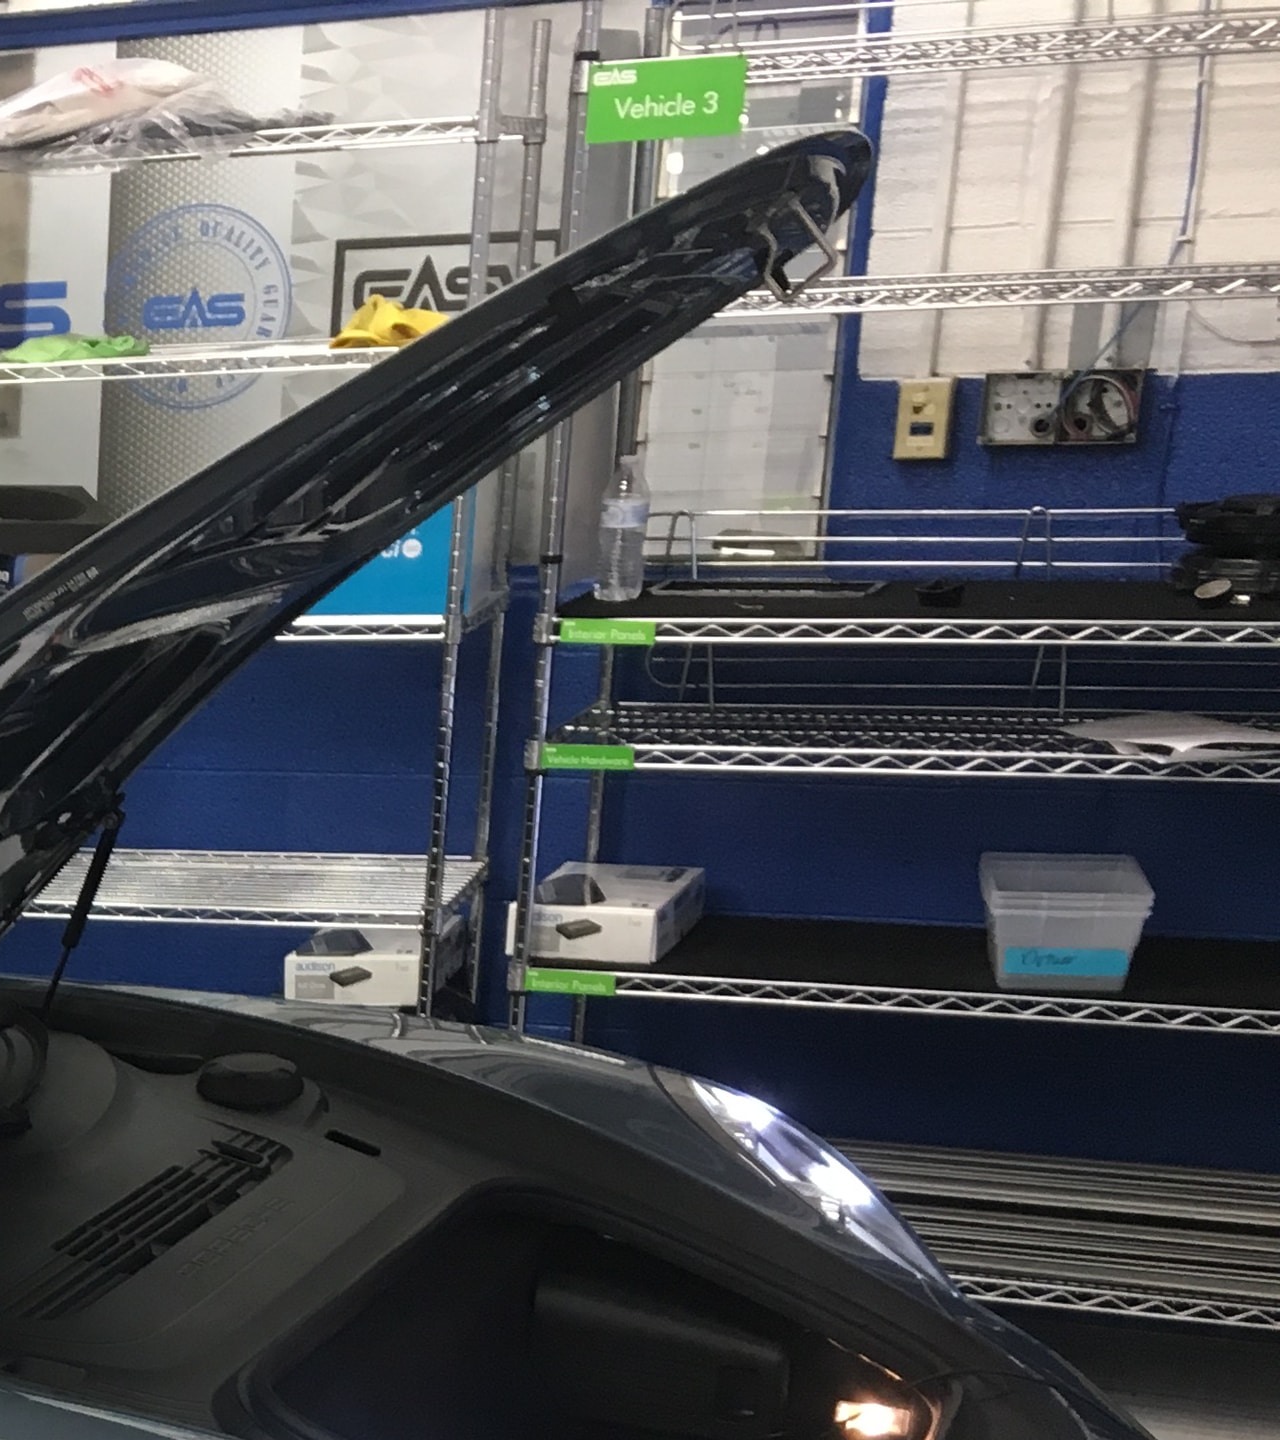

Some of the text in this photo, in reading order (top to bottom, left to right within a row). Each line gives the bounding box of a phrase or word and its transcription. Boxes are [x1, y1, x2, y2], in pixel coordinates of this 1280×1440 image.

[593, 68, 638, 87] EAS
[614, 91, 720, 119] Vehicle 3
[142, 287, 247, 331] EAS
